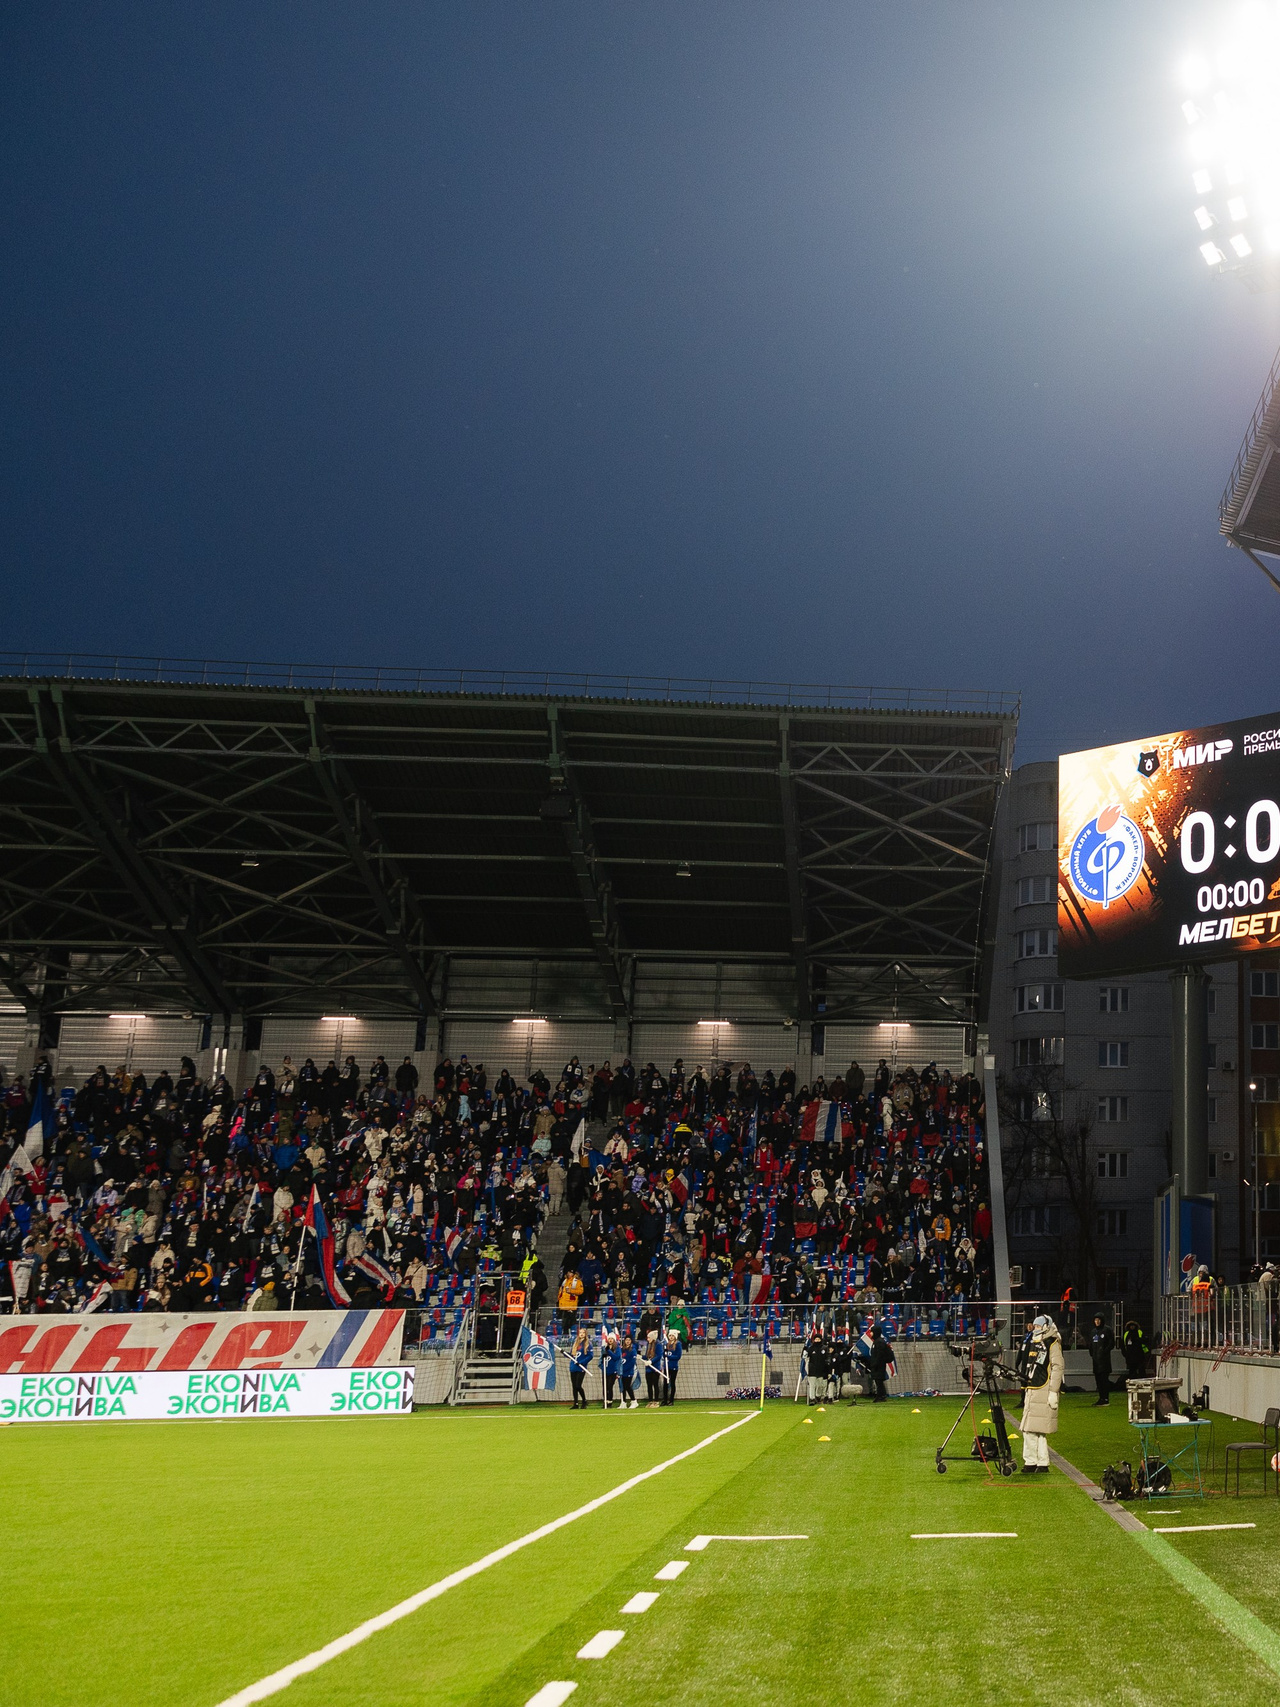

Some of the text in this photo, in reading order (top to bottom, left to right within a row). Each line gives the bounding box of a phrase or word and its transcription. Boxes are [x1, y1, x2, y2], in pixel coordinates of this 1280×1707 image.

[1173, 738, 1233, 769] МИР
[1197, 877, 1265, 912] 00:00
[510, 1295, 521, 1305] 68
[20, 1376, 139, 1398] EKONIVA
[187, 1372, 302, 1394] EKONIVA
[0, 1396, 127, 1418] ЭКОНИВА
[166, 1393, 291, 1415] ЭКОНИВА
